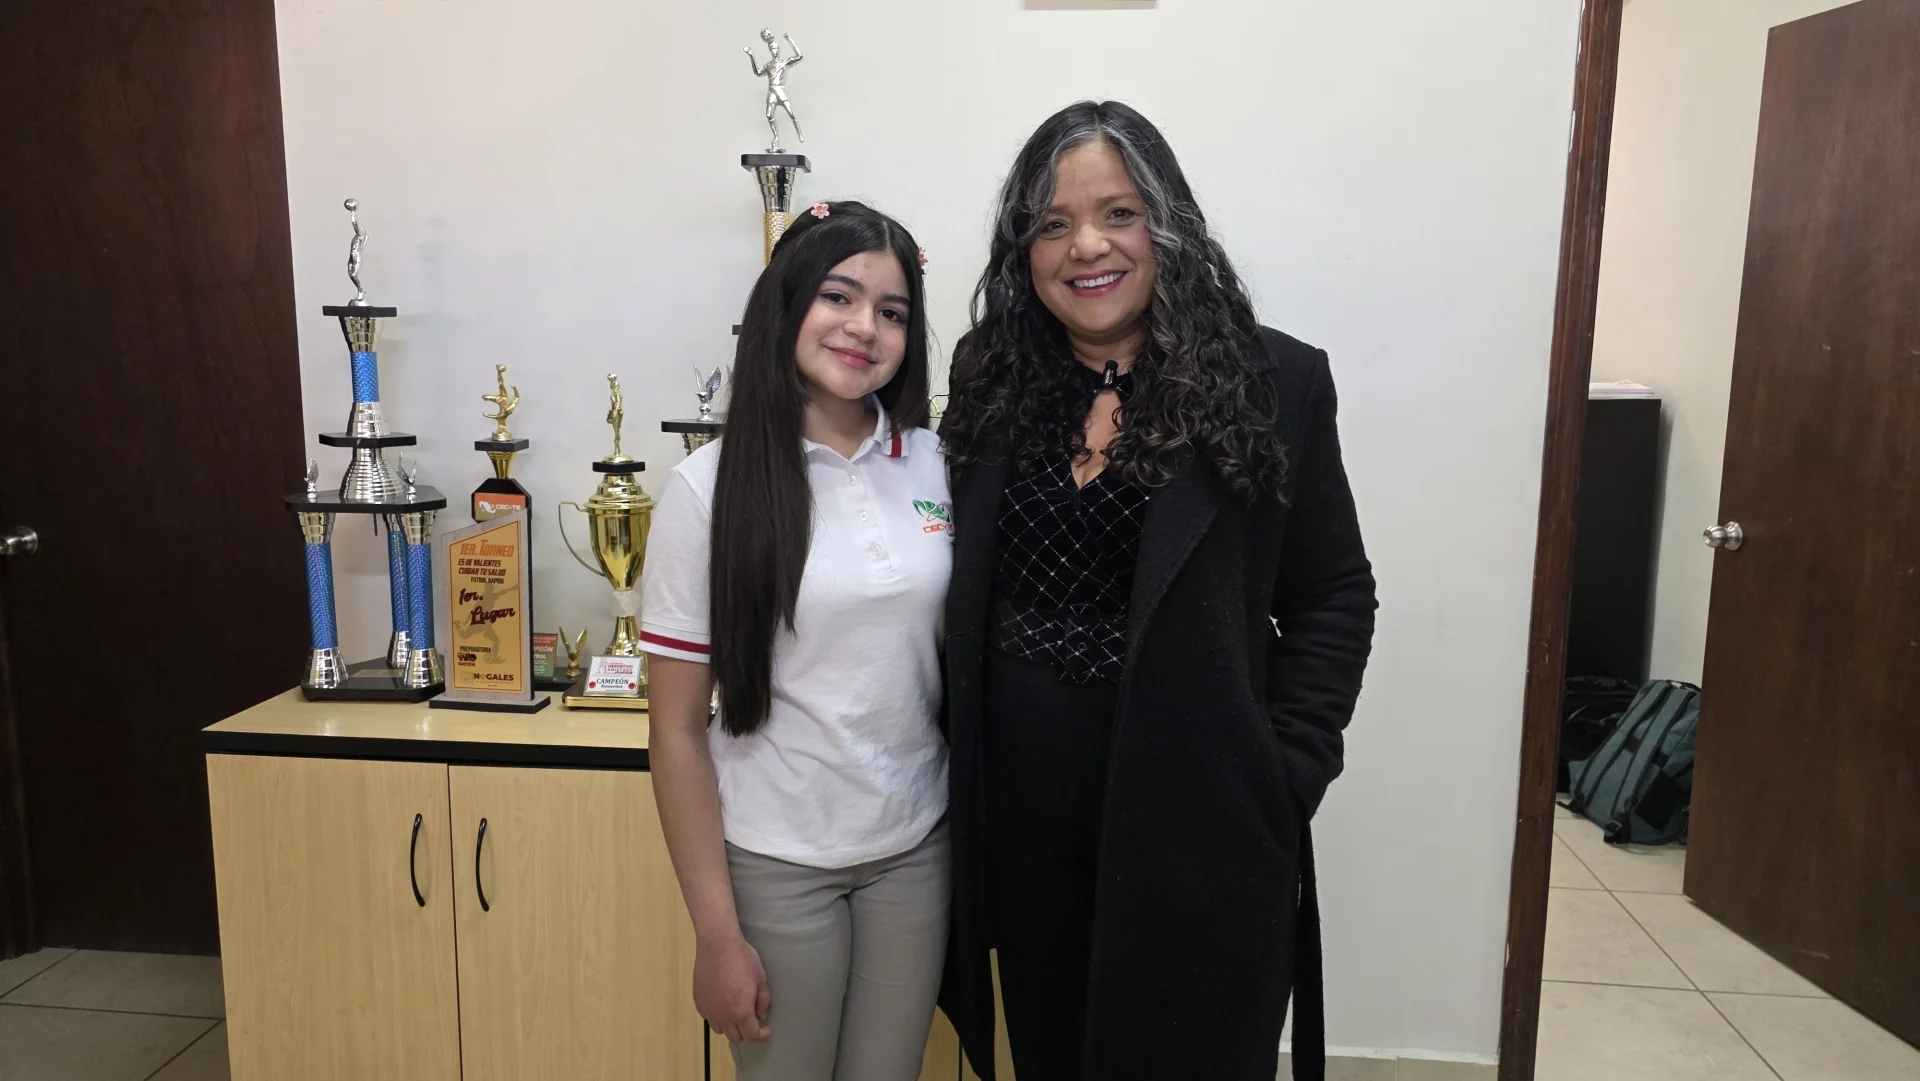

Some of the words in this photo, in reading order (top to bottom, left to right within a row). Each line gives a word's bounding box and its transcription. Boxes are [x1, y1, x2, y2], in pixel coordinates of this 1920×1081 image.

[458, 558, 466, 566] ES
[465, 558, 473, 566] DE
[473, 559, 502, 567] VALIENTES
[458, 567, 480, 575] CUIDAR
[480, 568, 488, 576] TU
[488, 568, 506, 576] SALUD
[459, 588, 483, 605] 1er.
[470, 605, 515, 625] Lugar
